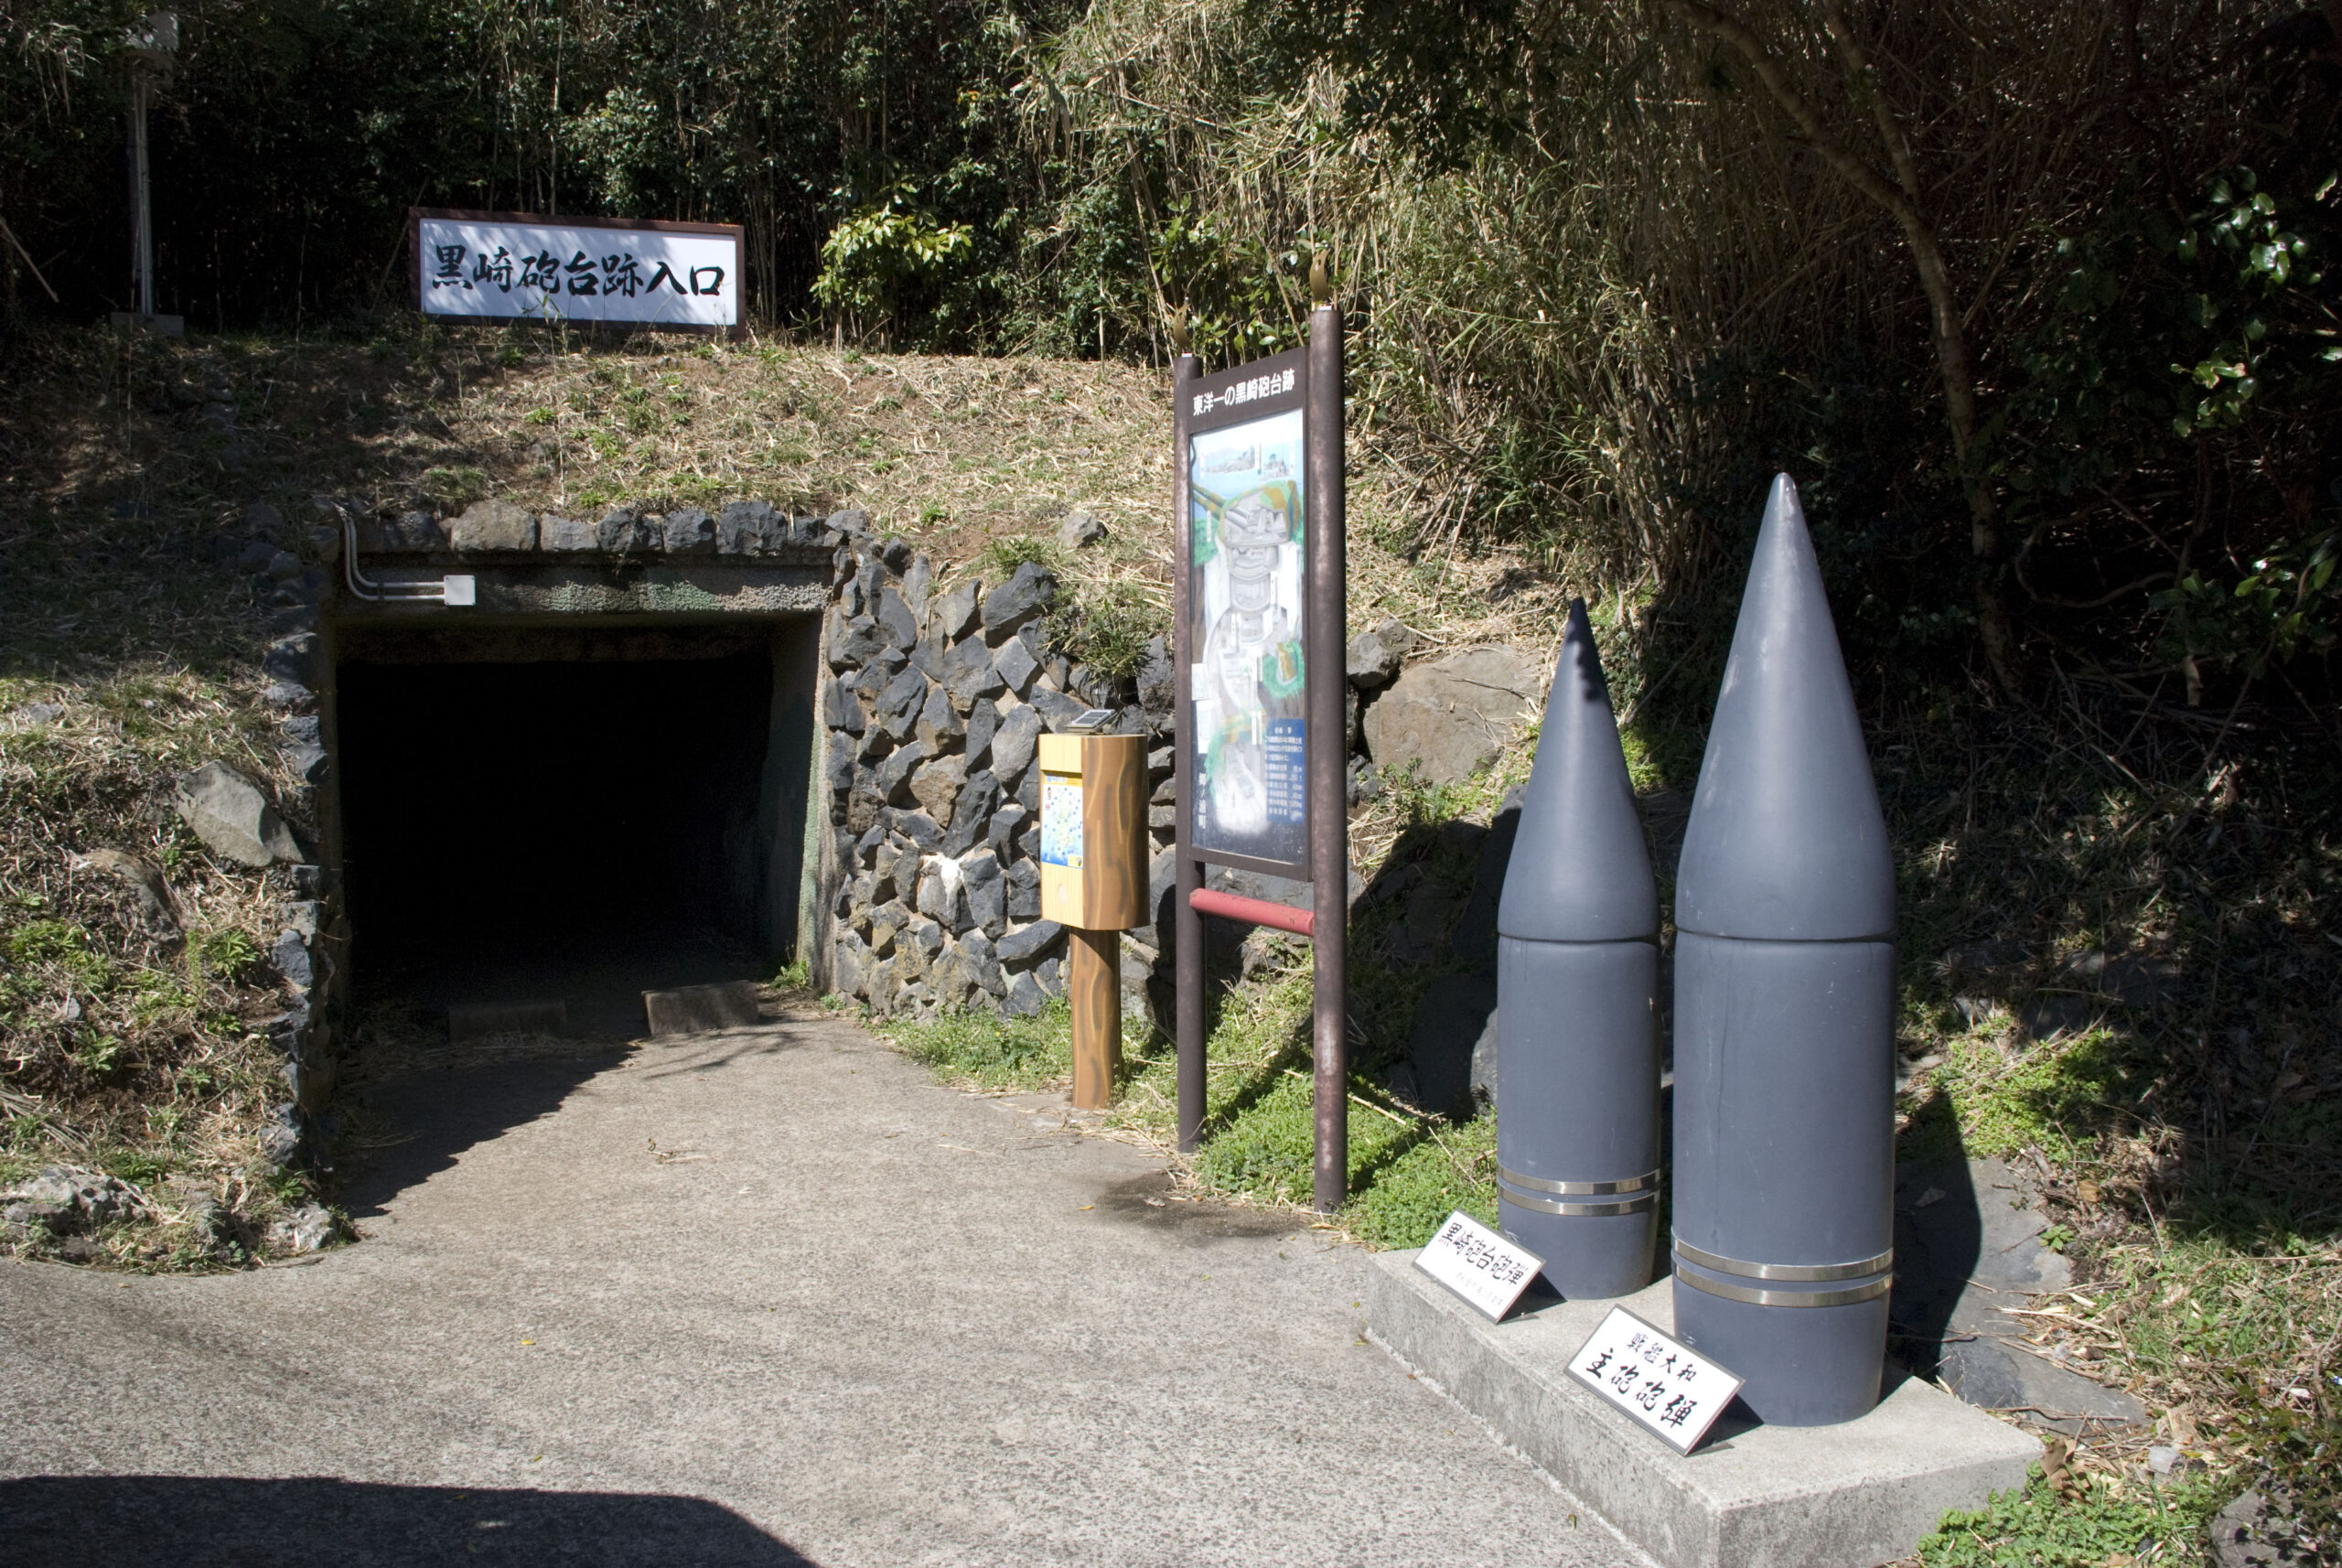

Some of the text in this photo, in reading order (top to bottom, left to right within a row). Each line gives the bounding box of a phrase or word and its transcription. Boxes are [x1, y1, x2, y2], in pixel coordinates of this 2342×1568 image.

[432, 244, 725, 296] 黒崎砲台跡入口
[1193, 369, 1295, 415] 東洋一の黒崎砲台跡
[1438, 1222, 1529, 1285] 黒崎砲台砲弾
[1586, 1348, 1697, 1428] 主砲砲弾
